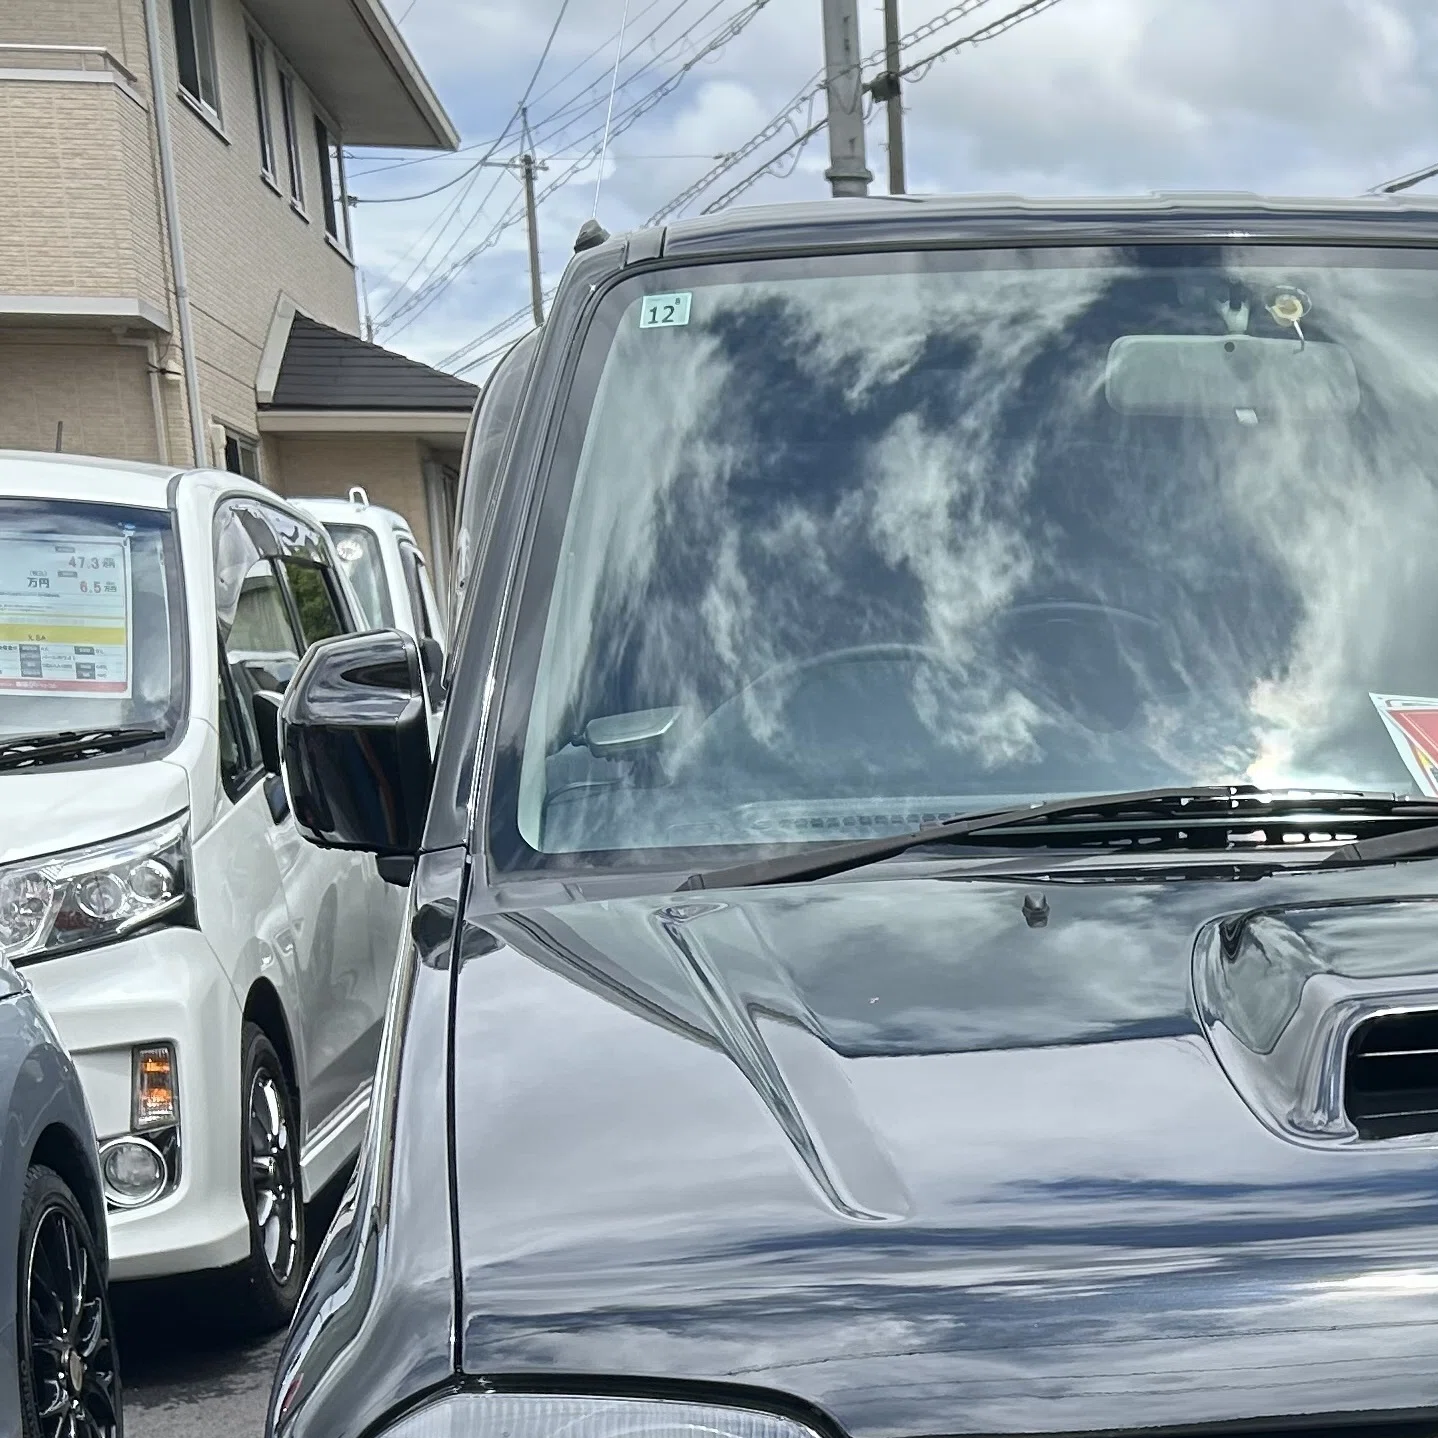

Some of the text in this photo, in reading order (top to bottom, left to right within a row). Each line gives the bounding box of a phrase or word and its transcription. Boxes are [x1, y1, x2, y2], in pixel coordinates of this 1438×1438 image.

[648, 305, 675, 324] 12
[68, 556, 99, 569] 47.3
[27, 577, 50, 589] 万円
[80, 581, 101, 594] 6.5
